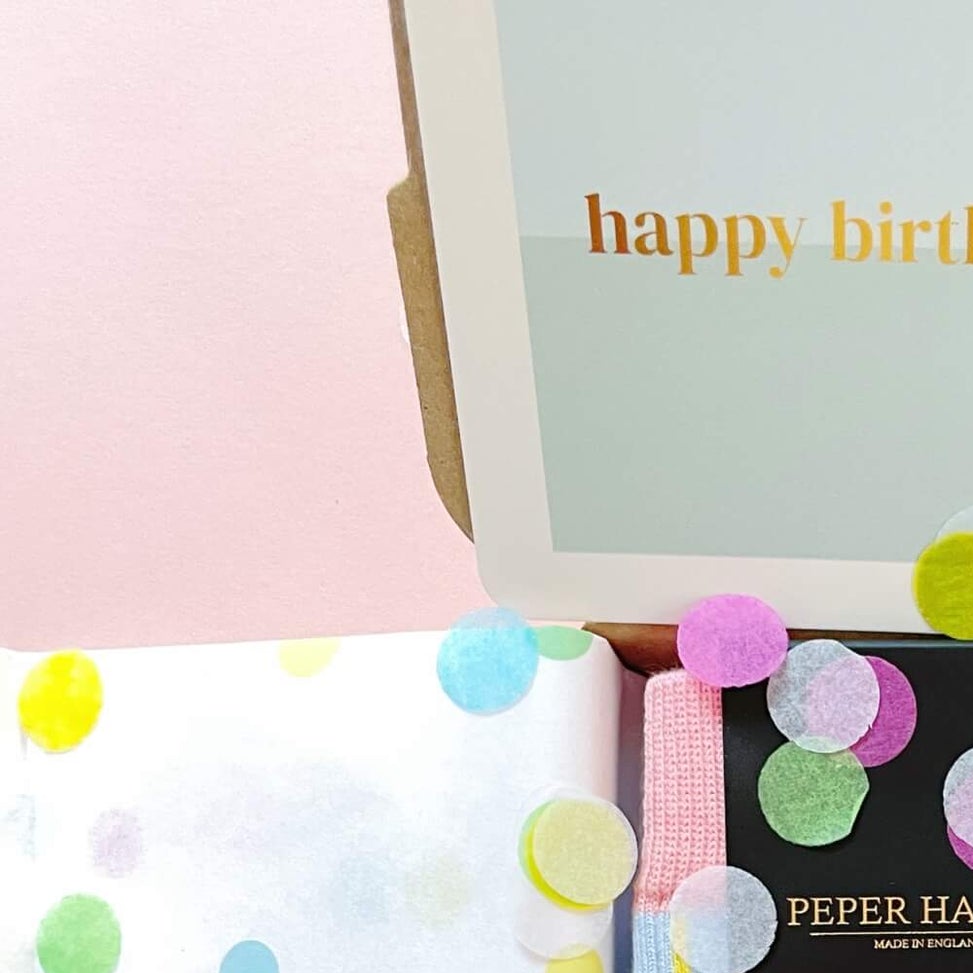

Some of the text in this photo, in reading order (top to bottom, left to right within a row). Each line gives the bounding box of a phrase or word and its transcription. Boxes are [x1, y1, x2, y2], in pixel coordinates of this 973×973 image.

[584, 192, 806, 279] happy
[786, 896, 912, 926] PEPER
[874, 939, 909, 950] MADE
[912, 939, 925, 949] IN
